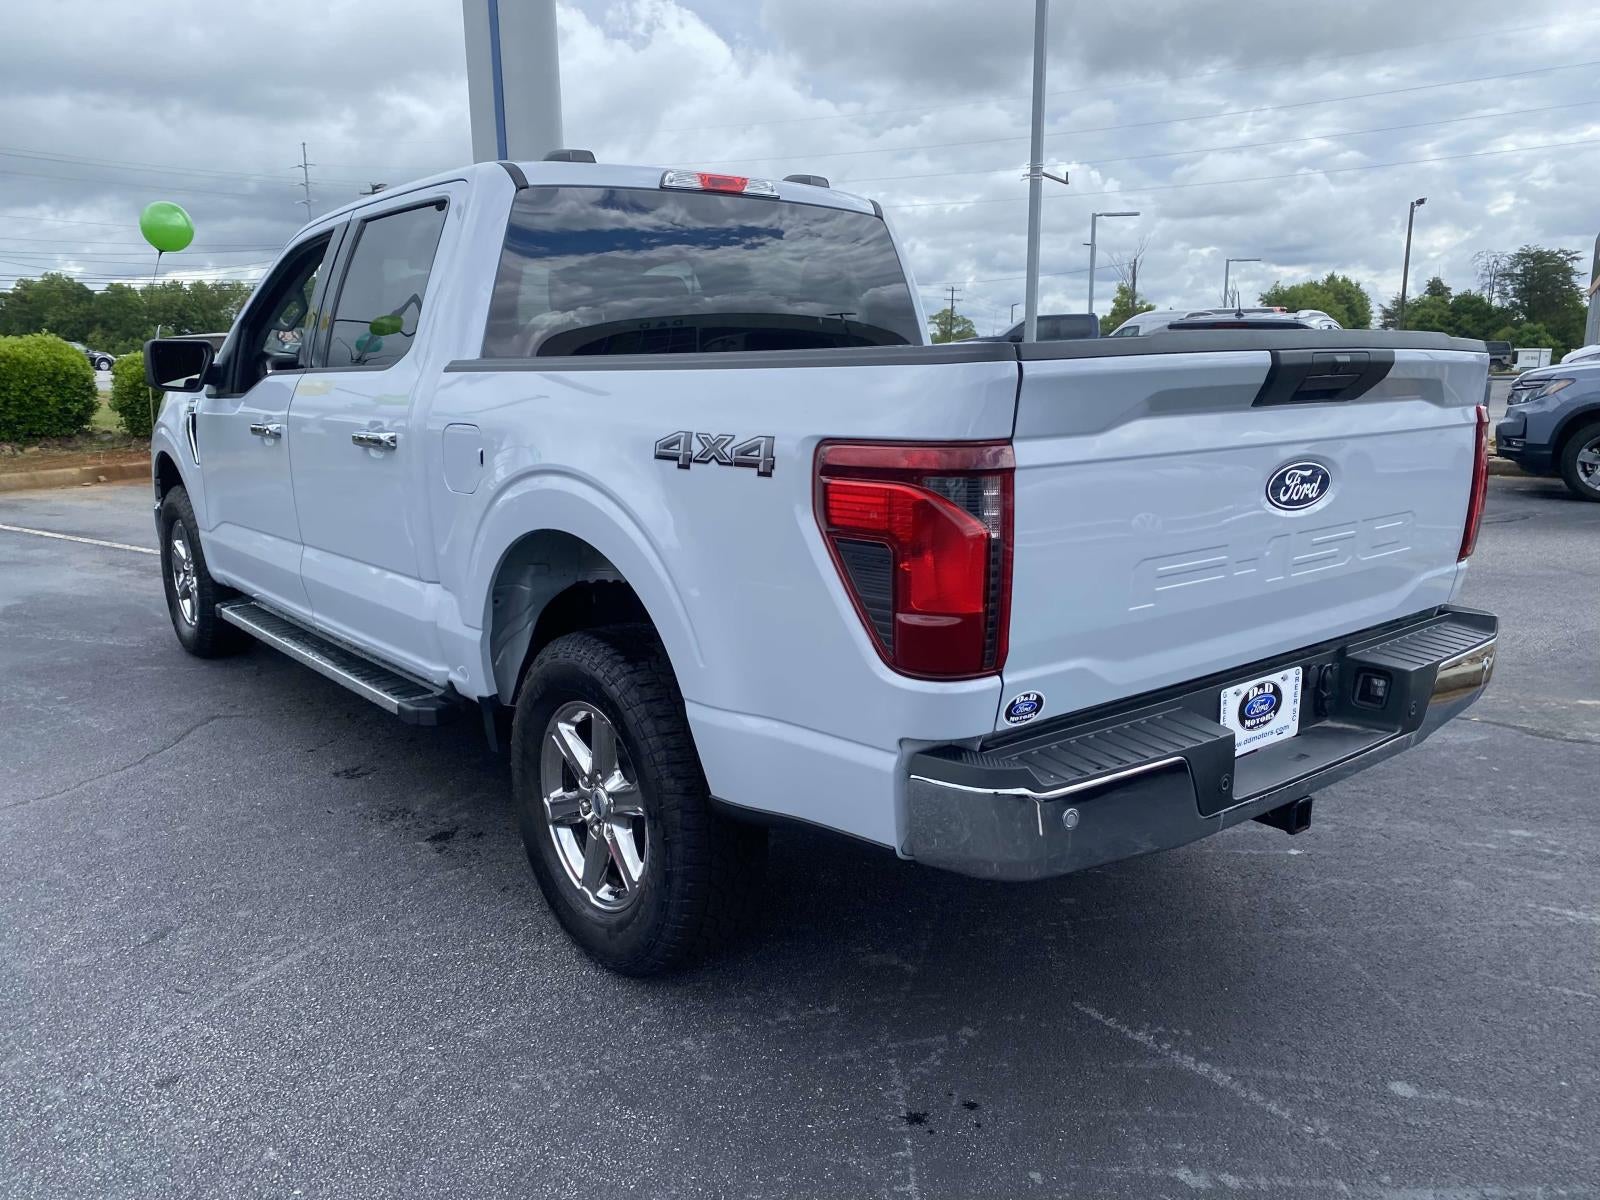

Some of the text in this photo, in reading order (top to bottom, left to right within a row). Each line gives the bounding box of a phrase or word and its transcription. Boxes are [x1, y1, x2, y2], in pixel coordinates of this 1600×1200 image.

[1279, 468, 1320, 502] Ford
[1247, 682, 1274, 700] D&D
[1250, 698, 1271, 715] Ford
[1235, 724, 1290, 747] w.ddmotors.com
